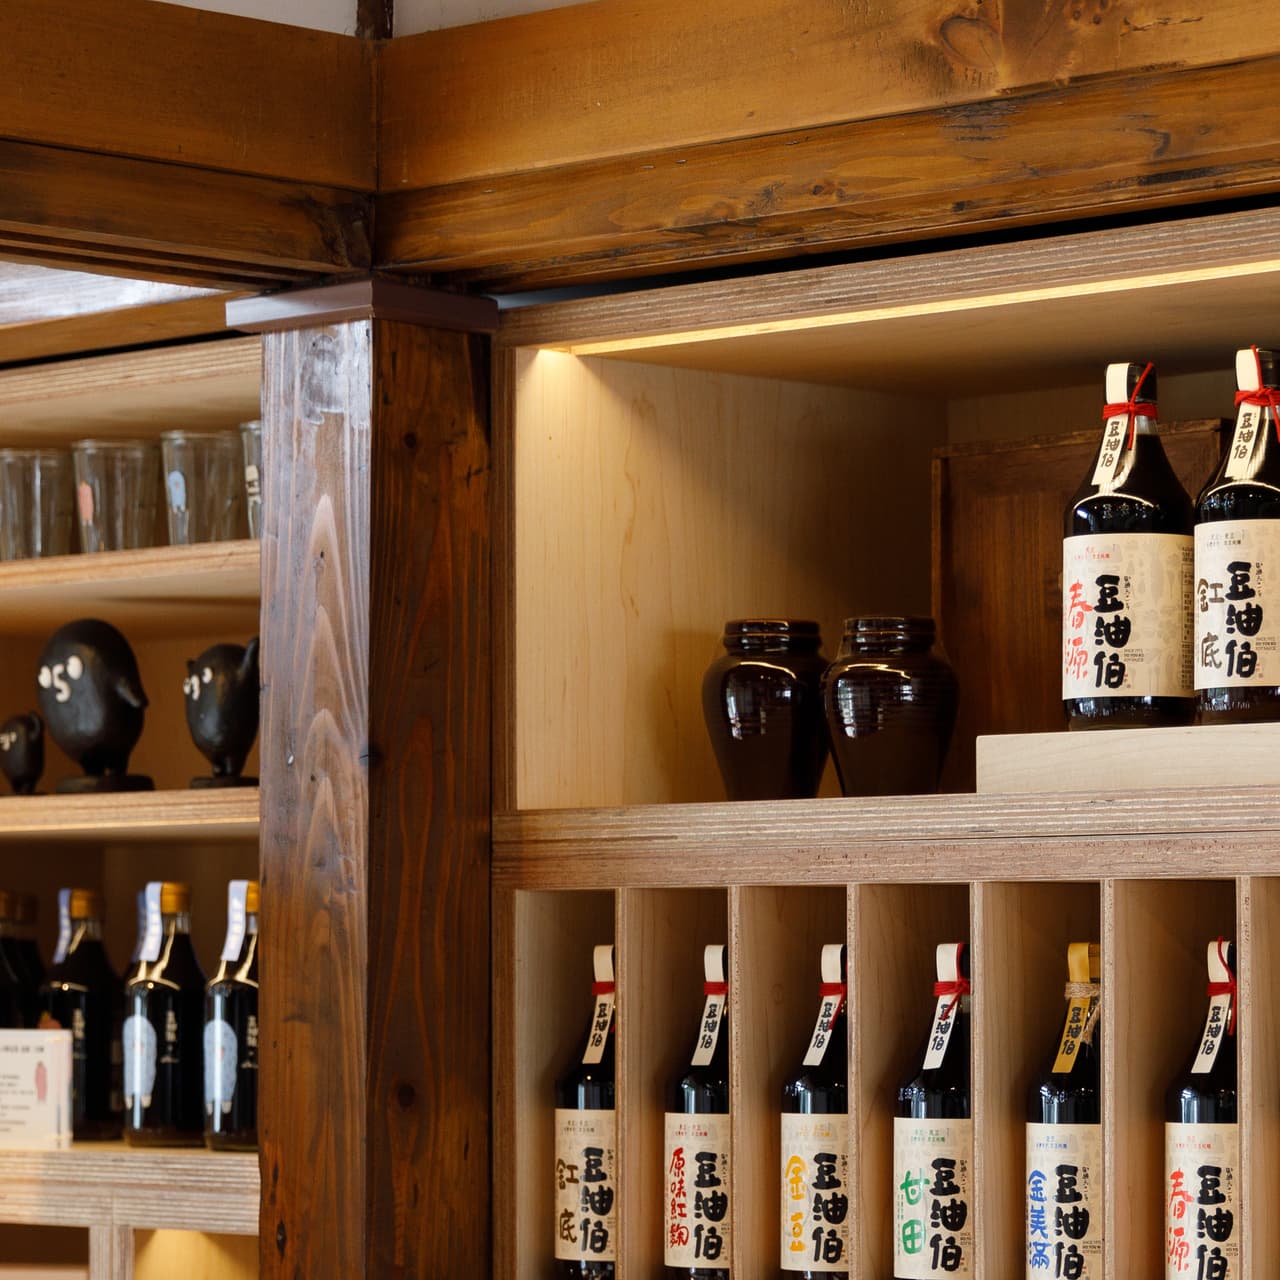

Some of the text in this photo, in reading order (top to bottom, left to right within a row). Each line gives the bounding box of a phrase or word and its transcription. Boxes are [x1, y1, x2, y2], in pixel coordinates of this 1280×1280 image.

[1100, 420, 1121, 468] 豆油伯
[1233, 411, 1253, 460] 豆油伯
[1094, 574, 1132, 689] 豆油伯
[1225, 561, 1264, 679] 豆油伯
[591, 1003, 608, 1047] 豆油伯
[700, 1003, 718, 1049] 豆油伯
[813, 1001, 833, 1049] 豆油伯
[1061, 1006, 1082, 1056] 豆油伯
[1201, 1006, 1222, 1056] 豆油伯
[580, 1147, 614, 1254] 豆油伯
[694, 1152, 728, 1260] 豆油伯
[812, 1153, 848, 1264] 豆油伯
[929, 1157, 968, 1272] 豆油伯
[1054, 1164, 1089, 1280] 豆油伯
